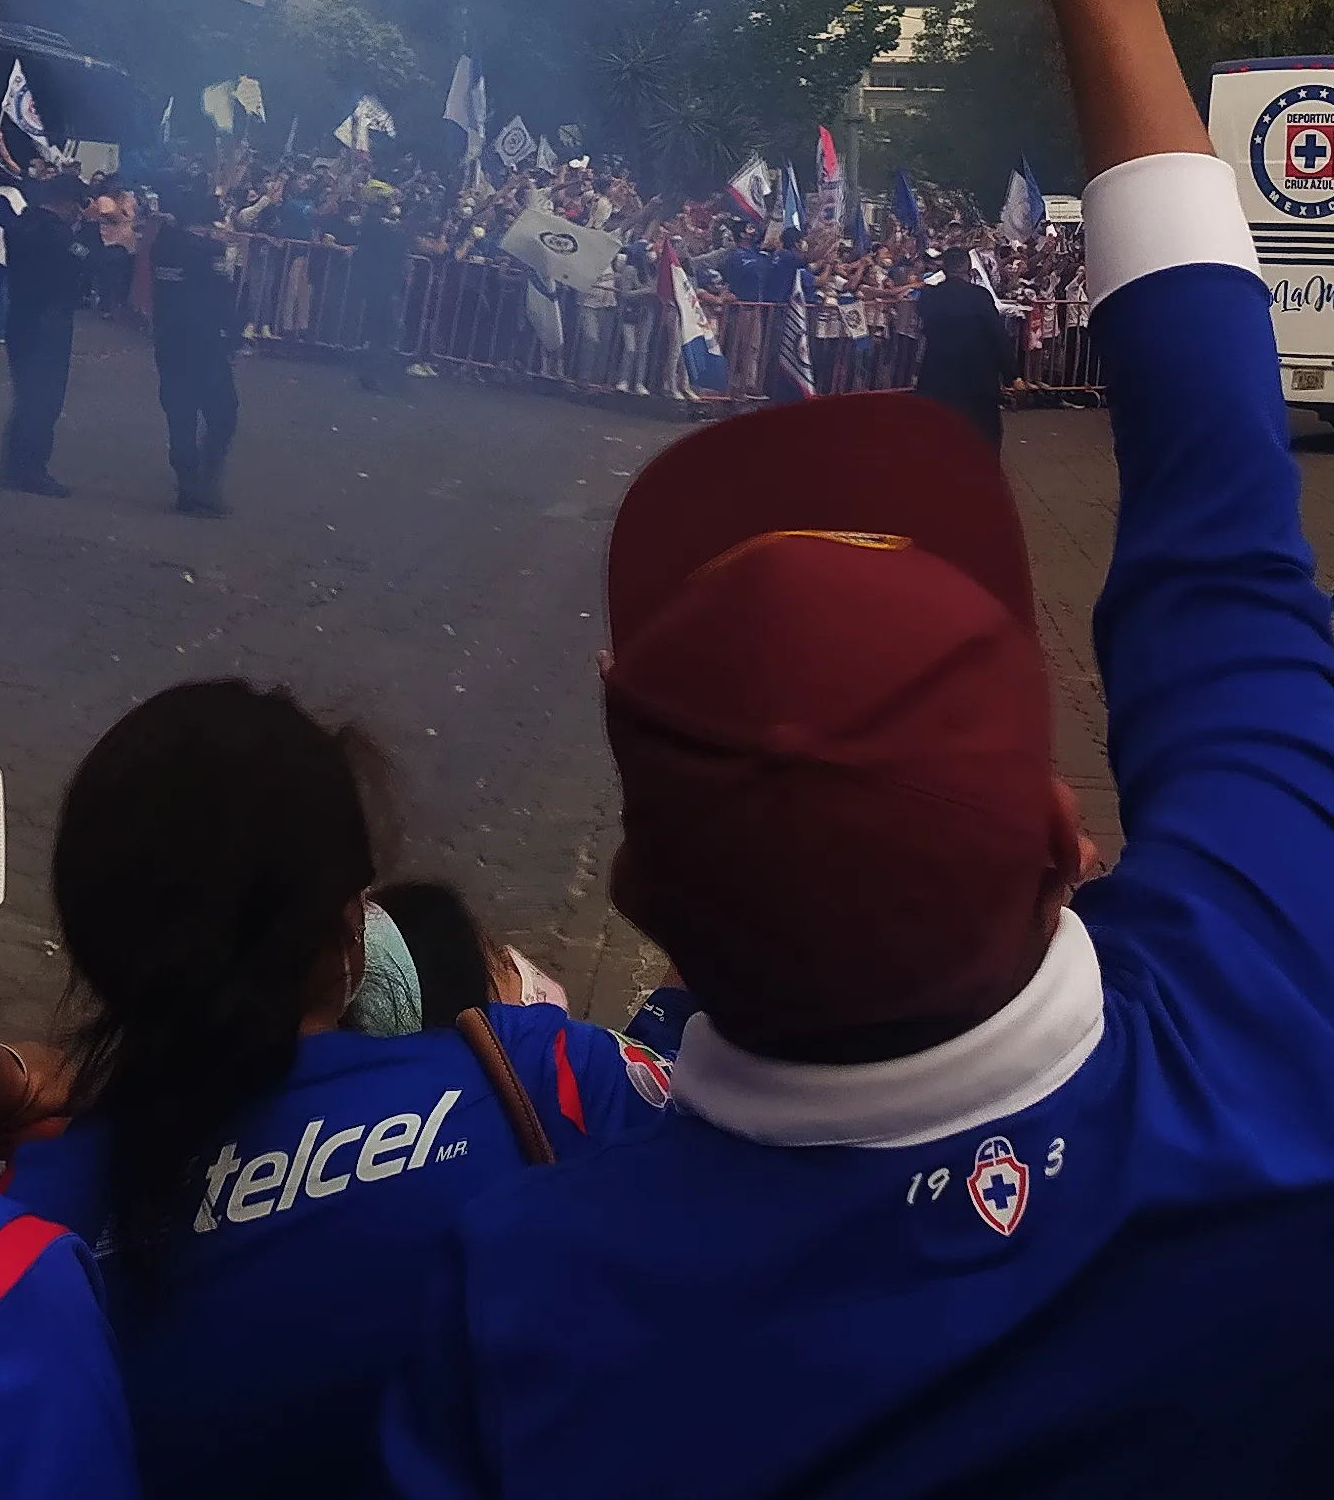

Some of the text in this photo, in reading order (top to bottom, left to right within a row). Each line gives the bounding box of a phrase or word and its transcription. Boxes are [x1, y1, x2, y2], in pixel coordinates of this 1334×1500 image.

[1284, 179, 1334, 191] CRUZ AZUL
[193, 1089, 462, 1233] telcel
[906, 1167, 950, 1205] 19
